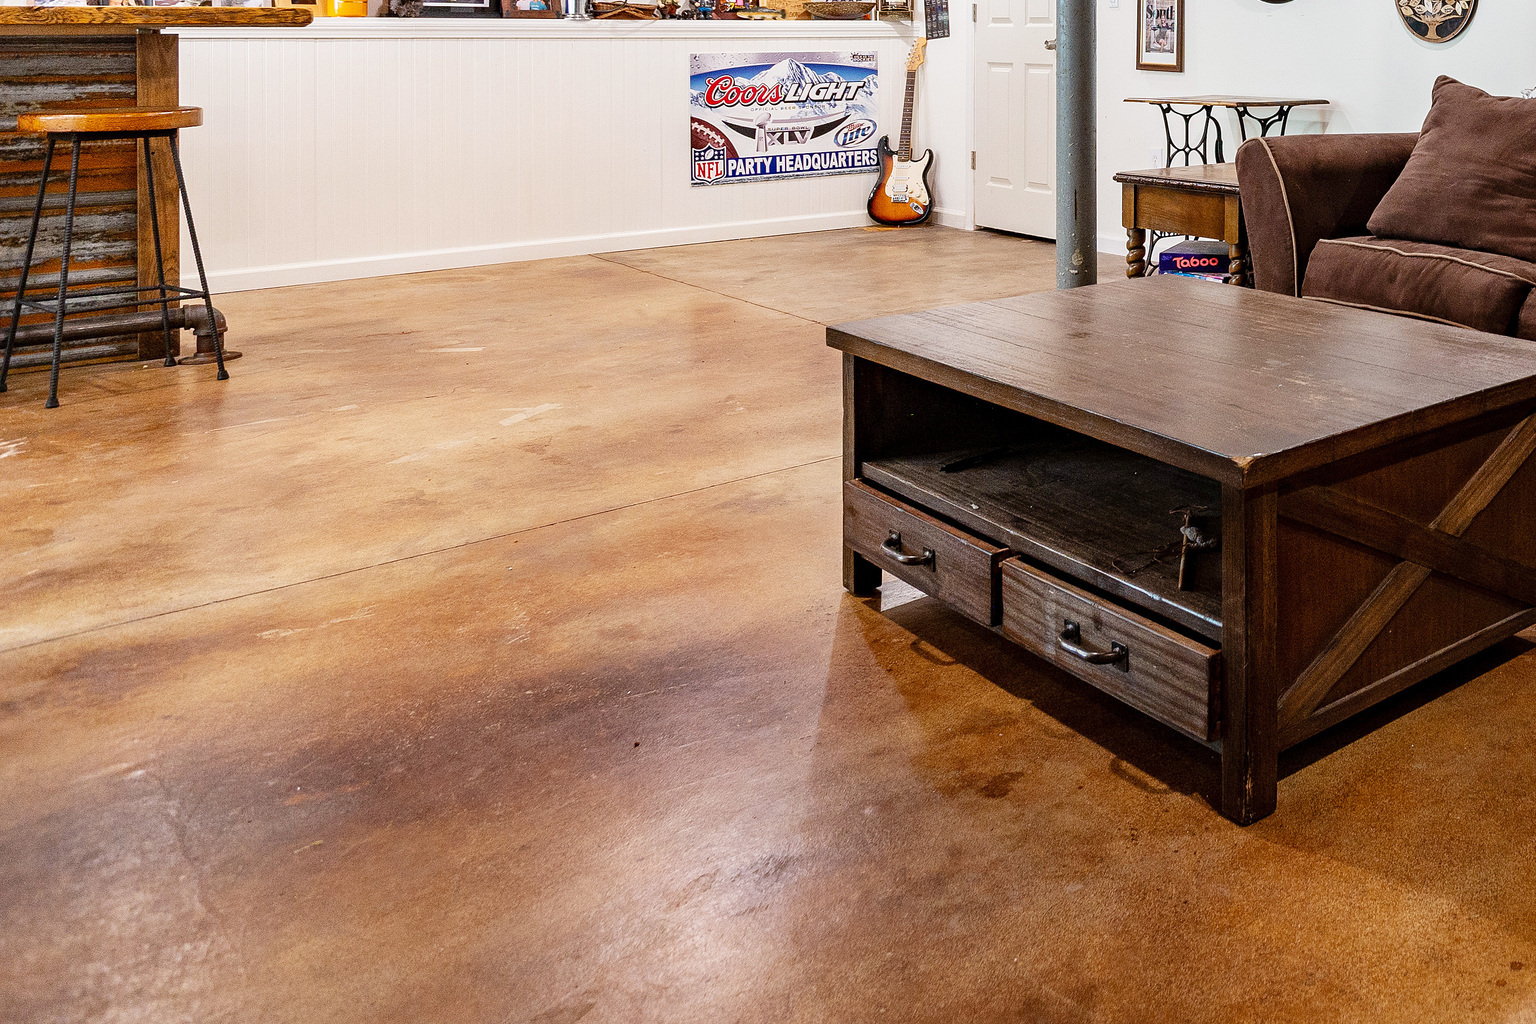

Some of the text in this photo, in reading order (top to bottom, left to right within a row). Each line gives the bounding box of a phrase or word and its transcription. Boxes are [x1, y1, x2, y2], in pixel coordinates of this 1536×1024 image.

[704, 75, 866, 108] Coors LIGHT
[766, 131, 811, 146] XLV
[842, 126, 871, 146] Lite
[696, 160, 723, 179] NFL
[727, 149, 878, 177] PARTY HEADQUARTERS
[1172, 256, 1219, 269] Taboo
